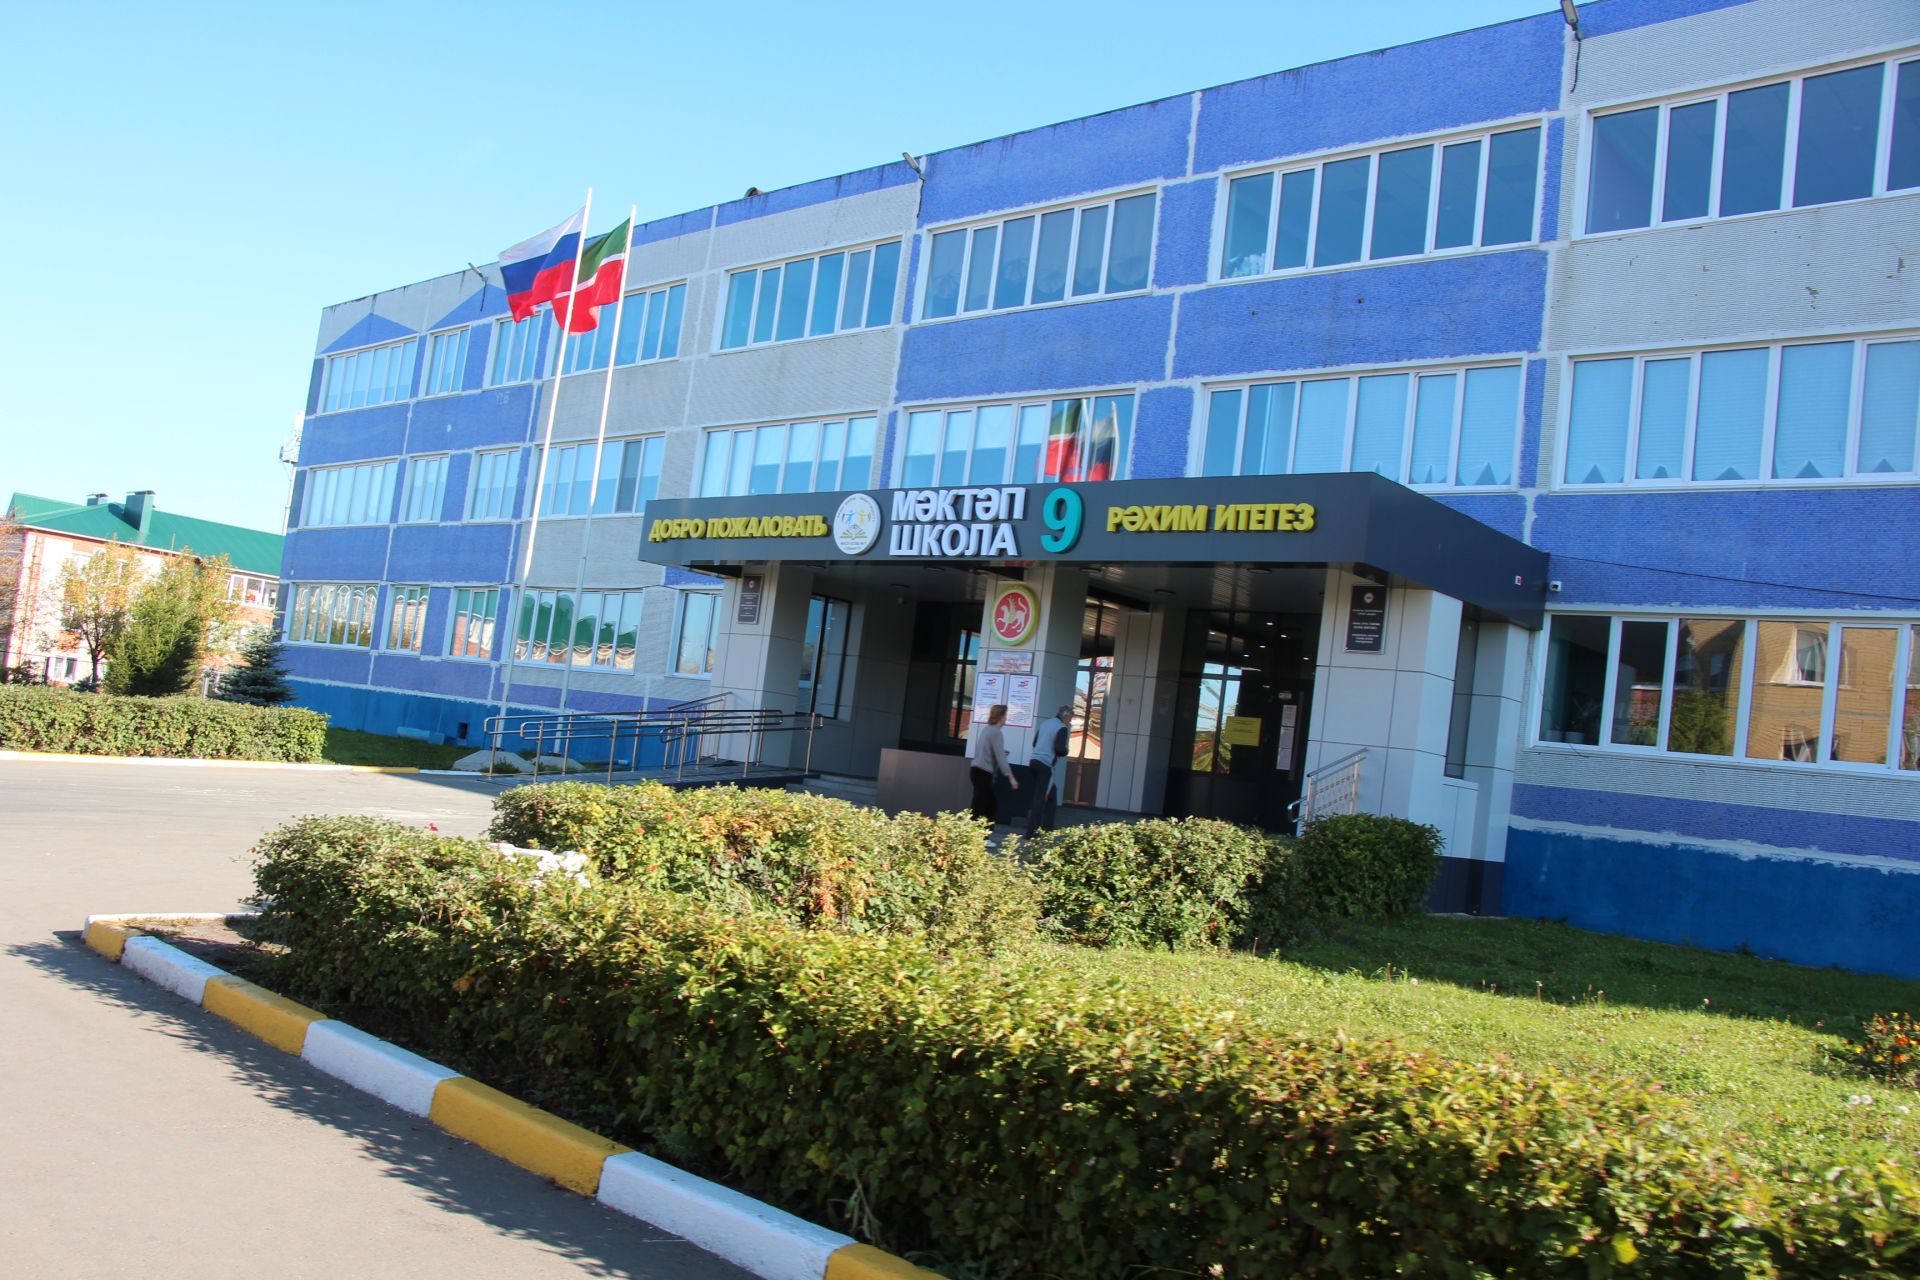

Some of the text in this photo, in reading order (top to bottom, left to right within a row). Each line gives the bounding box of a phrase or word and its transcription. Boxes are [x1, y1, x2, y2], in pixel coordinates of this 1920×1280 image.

[891, 487, 1026, 522] МӘКТӘП
[1040, 487, 1083, 553] 9
[1106, 503, 1315, 532] РӘХИМ ИТЕГЕЗ
[648, 515, 828, 541] ДОБРО ПОЖАЛОВАТЬ
[889, 523, 1018, 556] ШКОЛА
